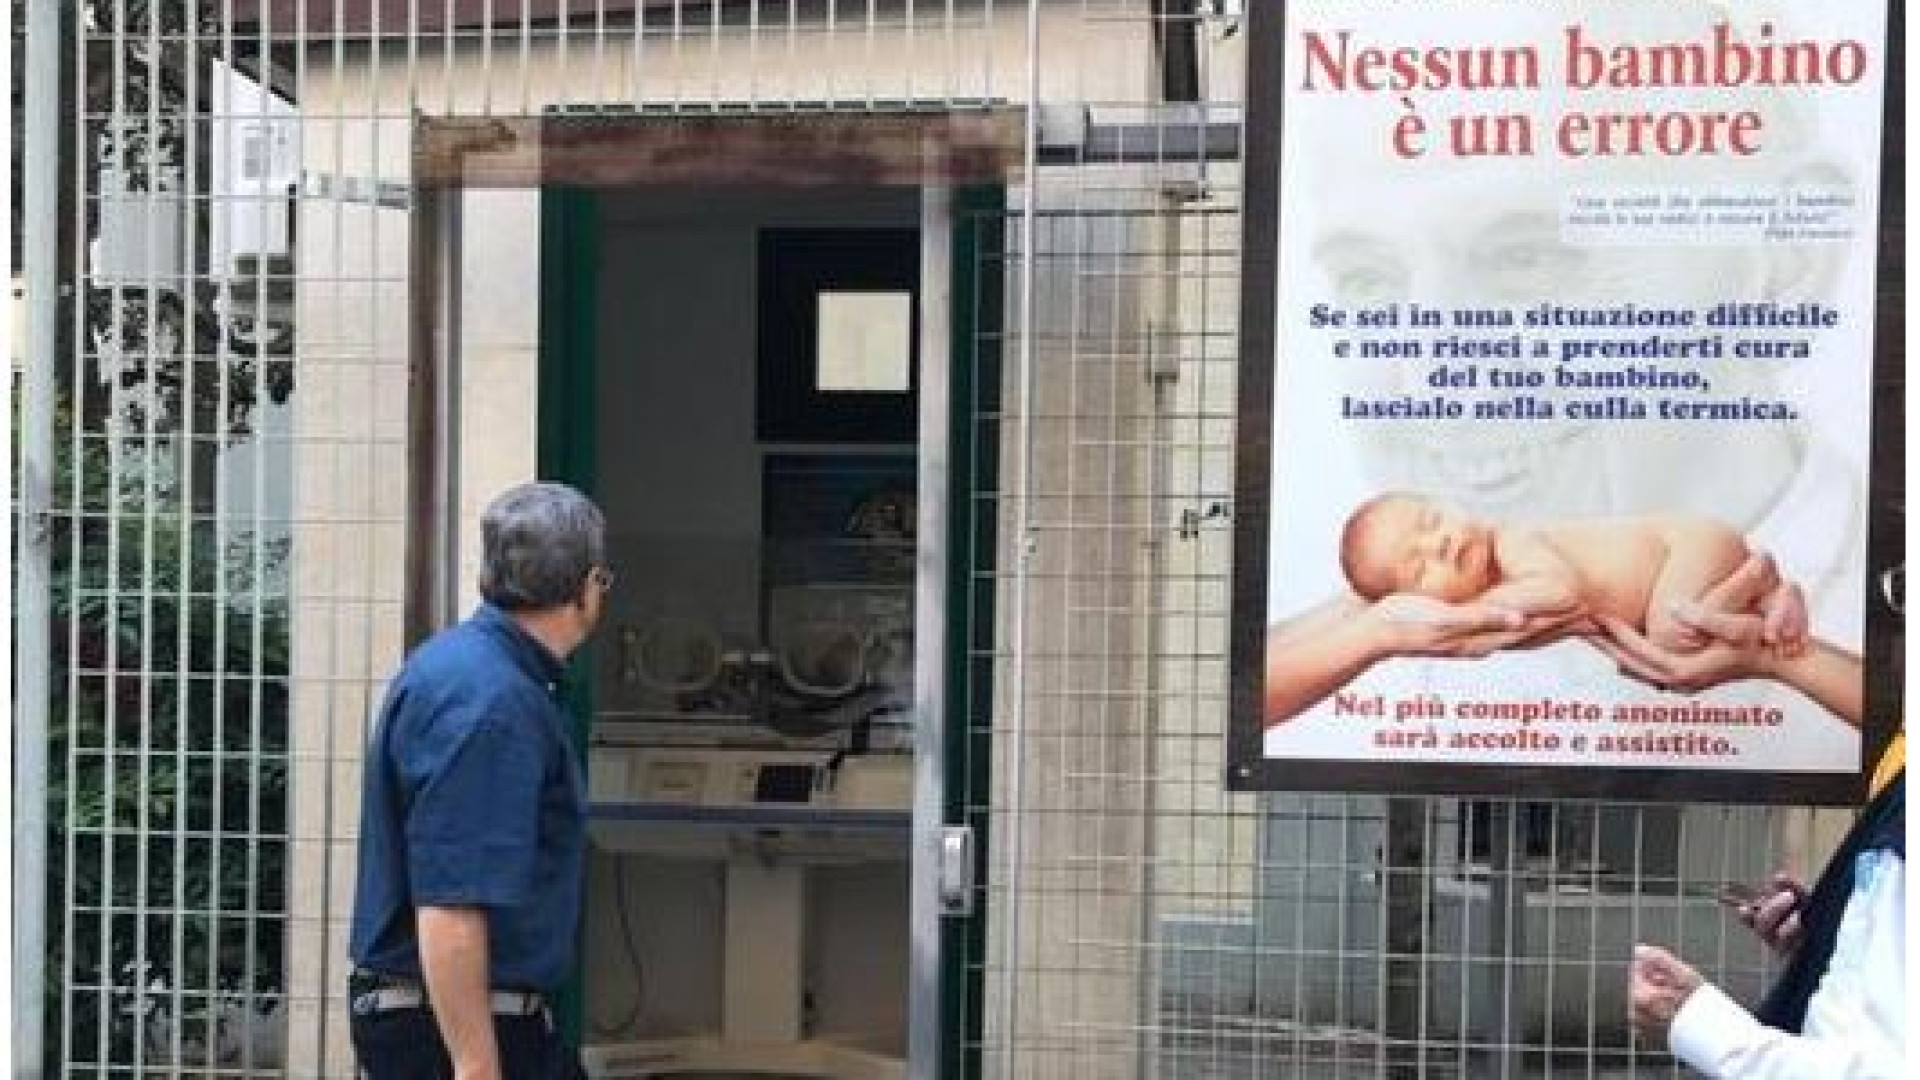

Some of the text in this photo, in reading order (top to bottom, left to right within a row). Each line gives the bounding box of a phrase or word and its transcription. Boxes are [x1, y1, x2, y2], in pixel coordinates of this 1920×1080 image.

[1301, 21, 1867, 93] Nessun bambino
[1392, 97, 1764, 158] è un errore
[1309, 302, 1838, 328] Se sei in una situazione difficile
[1334, 335, 1810, 363] e non riesci a prenderti cura
[1428, 364, 1711, 393] del tuo bambino,
[1342, 396, 1799, 420] lascialo nella culla termica.
[1334, 693, 1784, 727] Nel più completo anonimato
[1374, 727, 1740, 756] sarà accolto e assistito.
